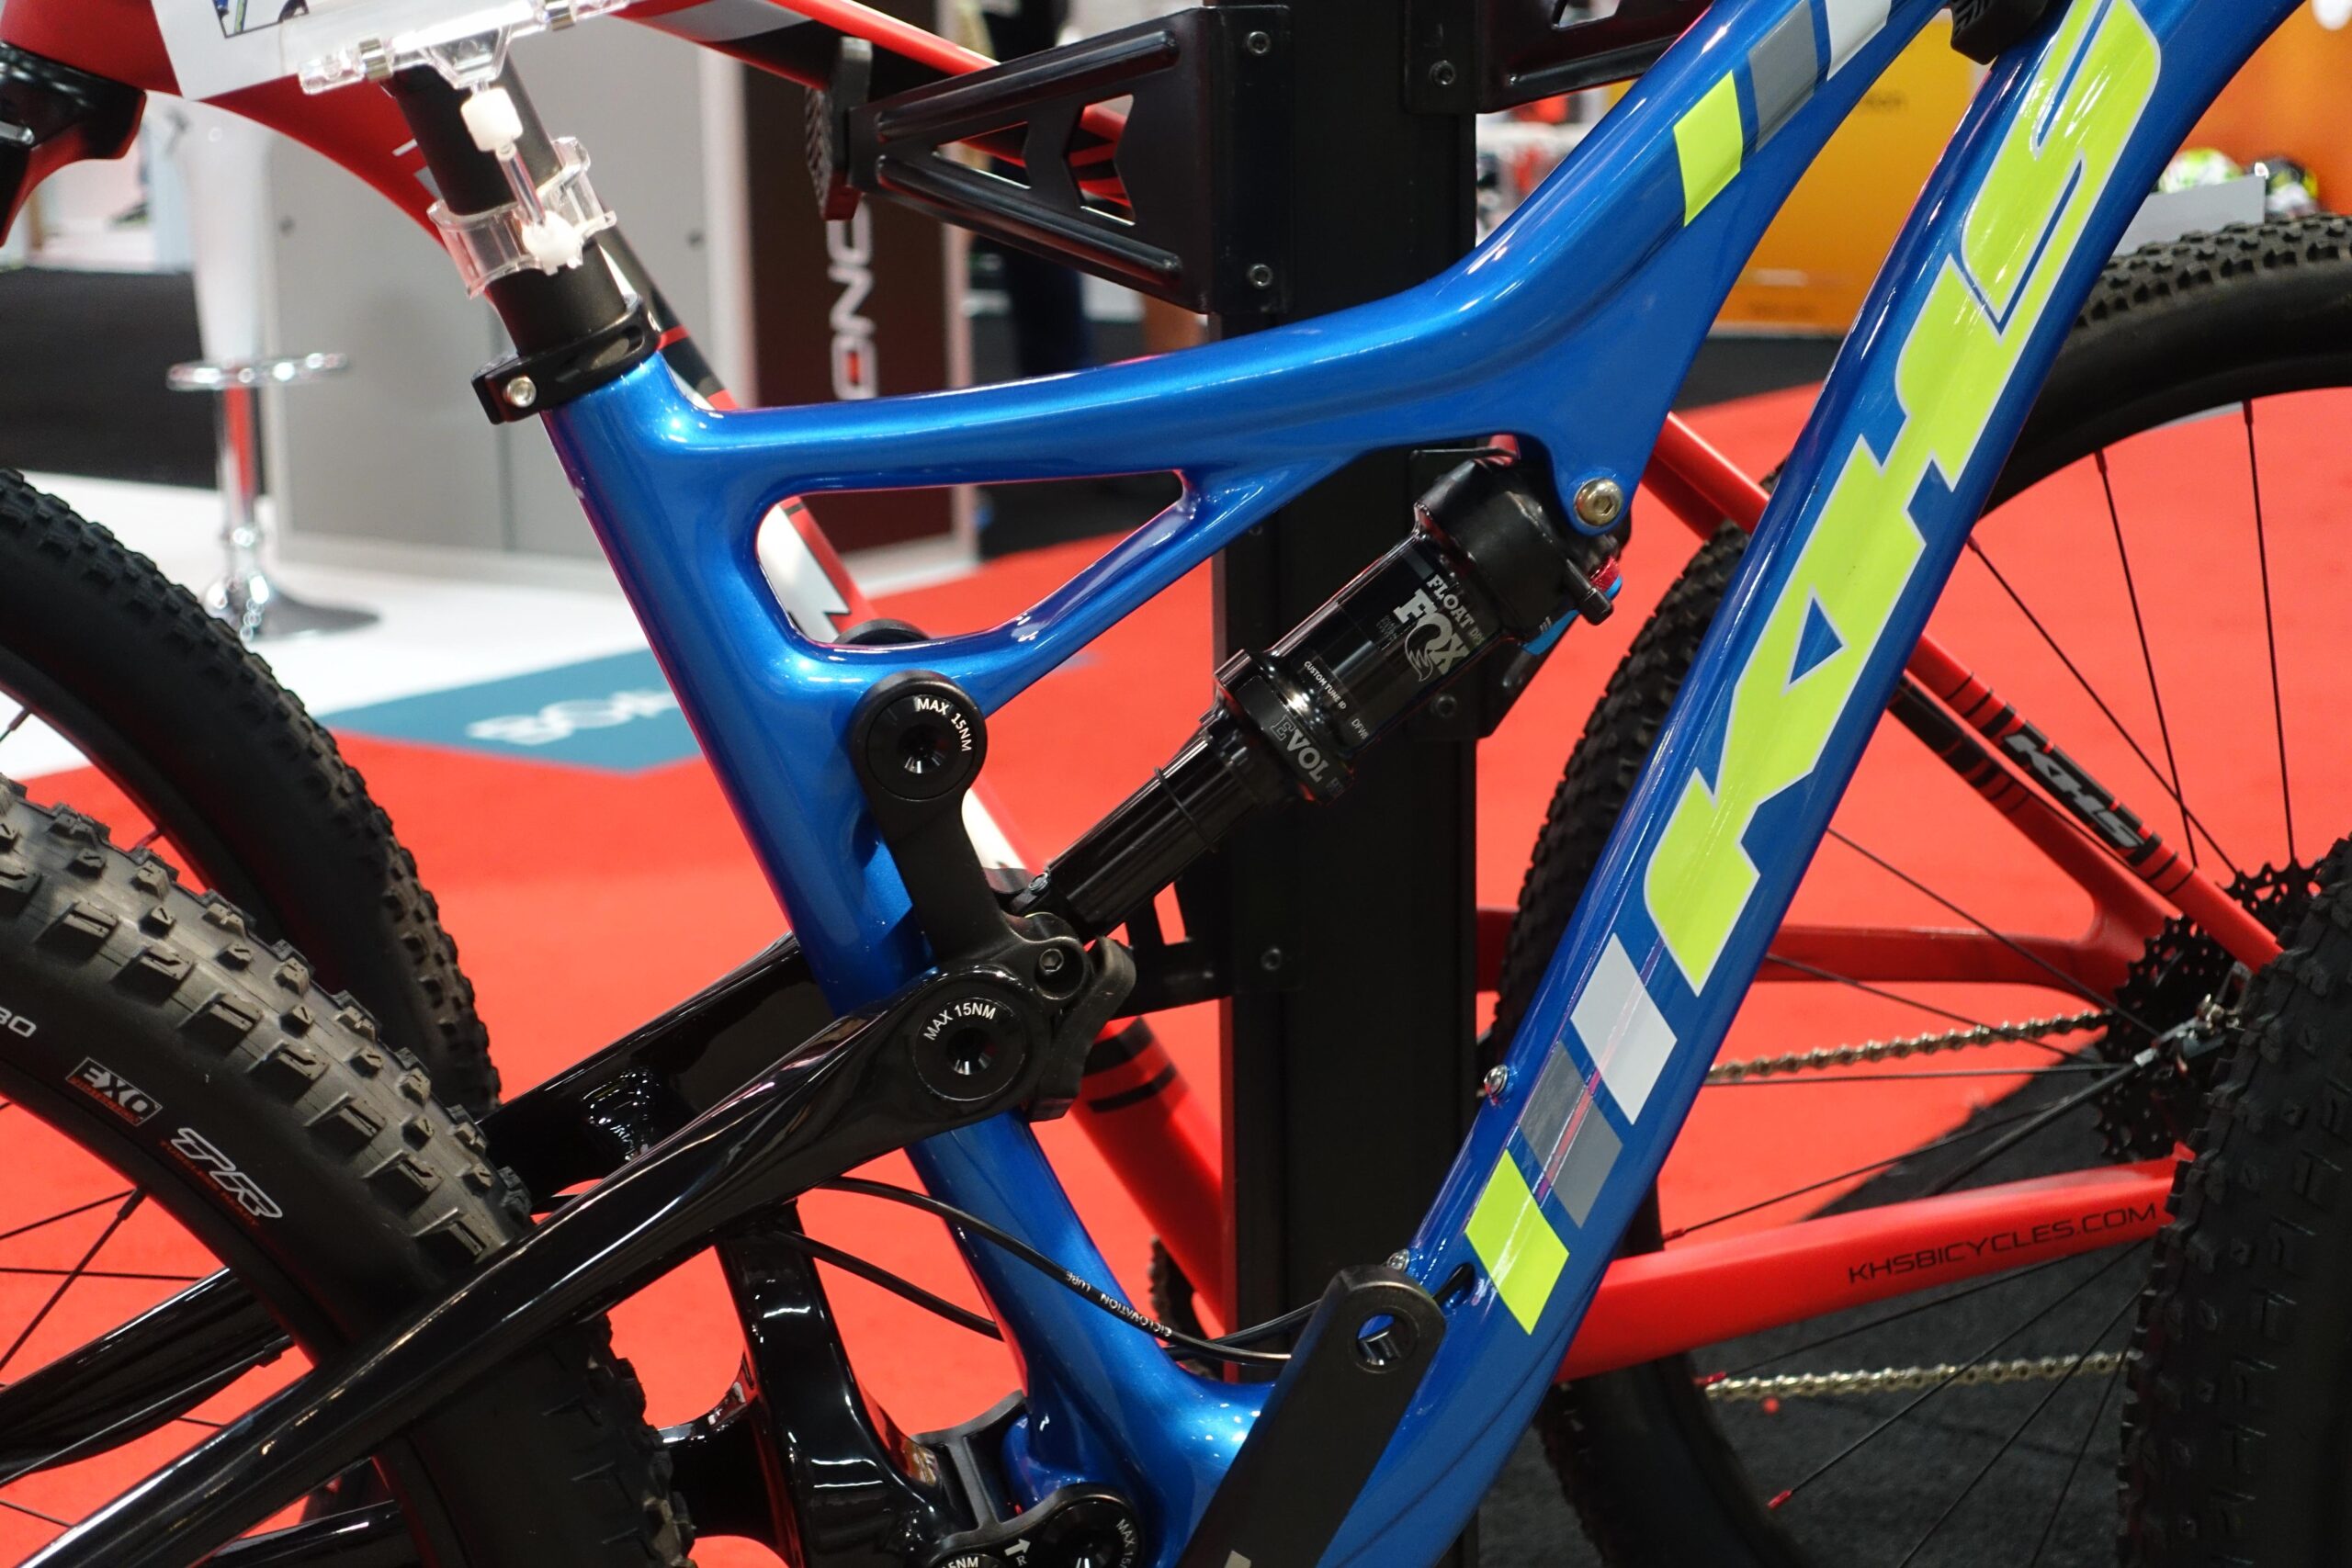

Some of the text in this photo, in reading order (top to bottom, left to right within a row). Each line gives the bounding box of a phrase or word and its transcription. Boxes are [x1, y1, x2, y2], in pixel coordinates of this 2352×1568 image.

[1644, 0, 2162, 997] KHS
[1426, 574, 1476, 629] FLOAT
[1393, 588, 1471, 682] FOX
[1304, 660, 1348, 711] CUSTOM TUNE ID
[917, 697, 973, 752] MAX 15NM
[1270, 715, 1329, 784] EVOL
[2003, 733, 2146, 849] KHS
[922, 1001, 997, 1041] MAX 15NM
[73, 1058, 161, 1116] EXO
[170, 1127, 283, 1218] TR
[1848, 1202, 2157, 1285] KHSBICYCLES.COM
[1065, 1269, 1091, 1292] LUBE
[1015, 1554, 1028, 1567] R
[1115, 1517, 1136, 1549] MAX
[942, 1555, 978, 1568] 5NM
